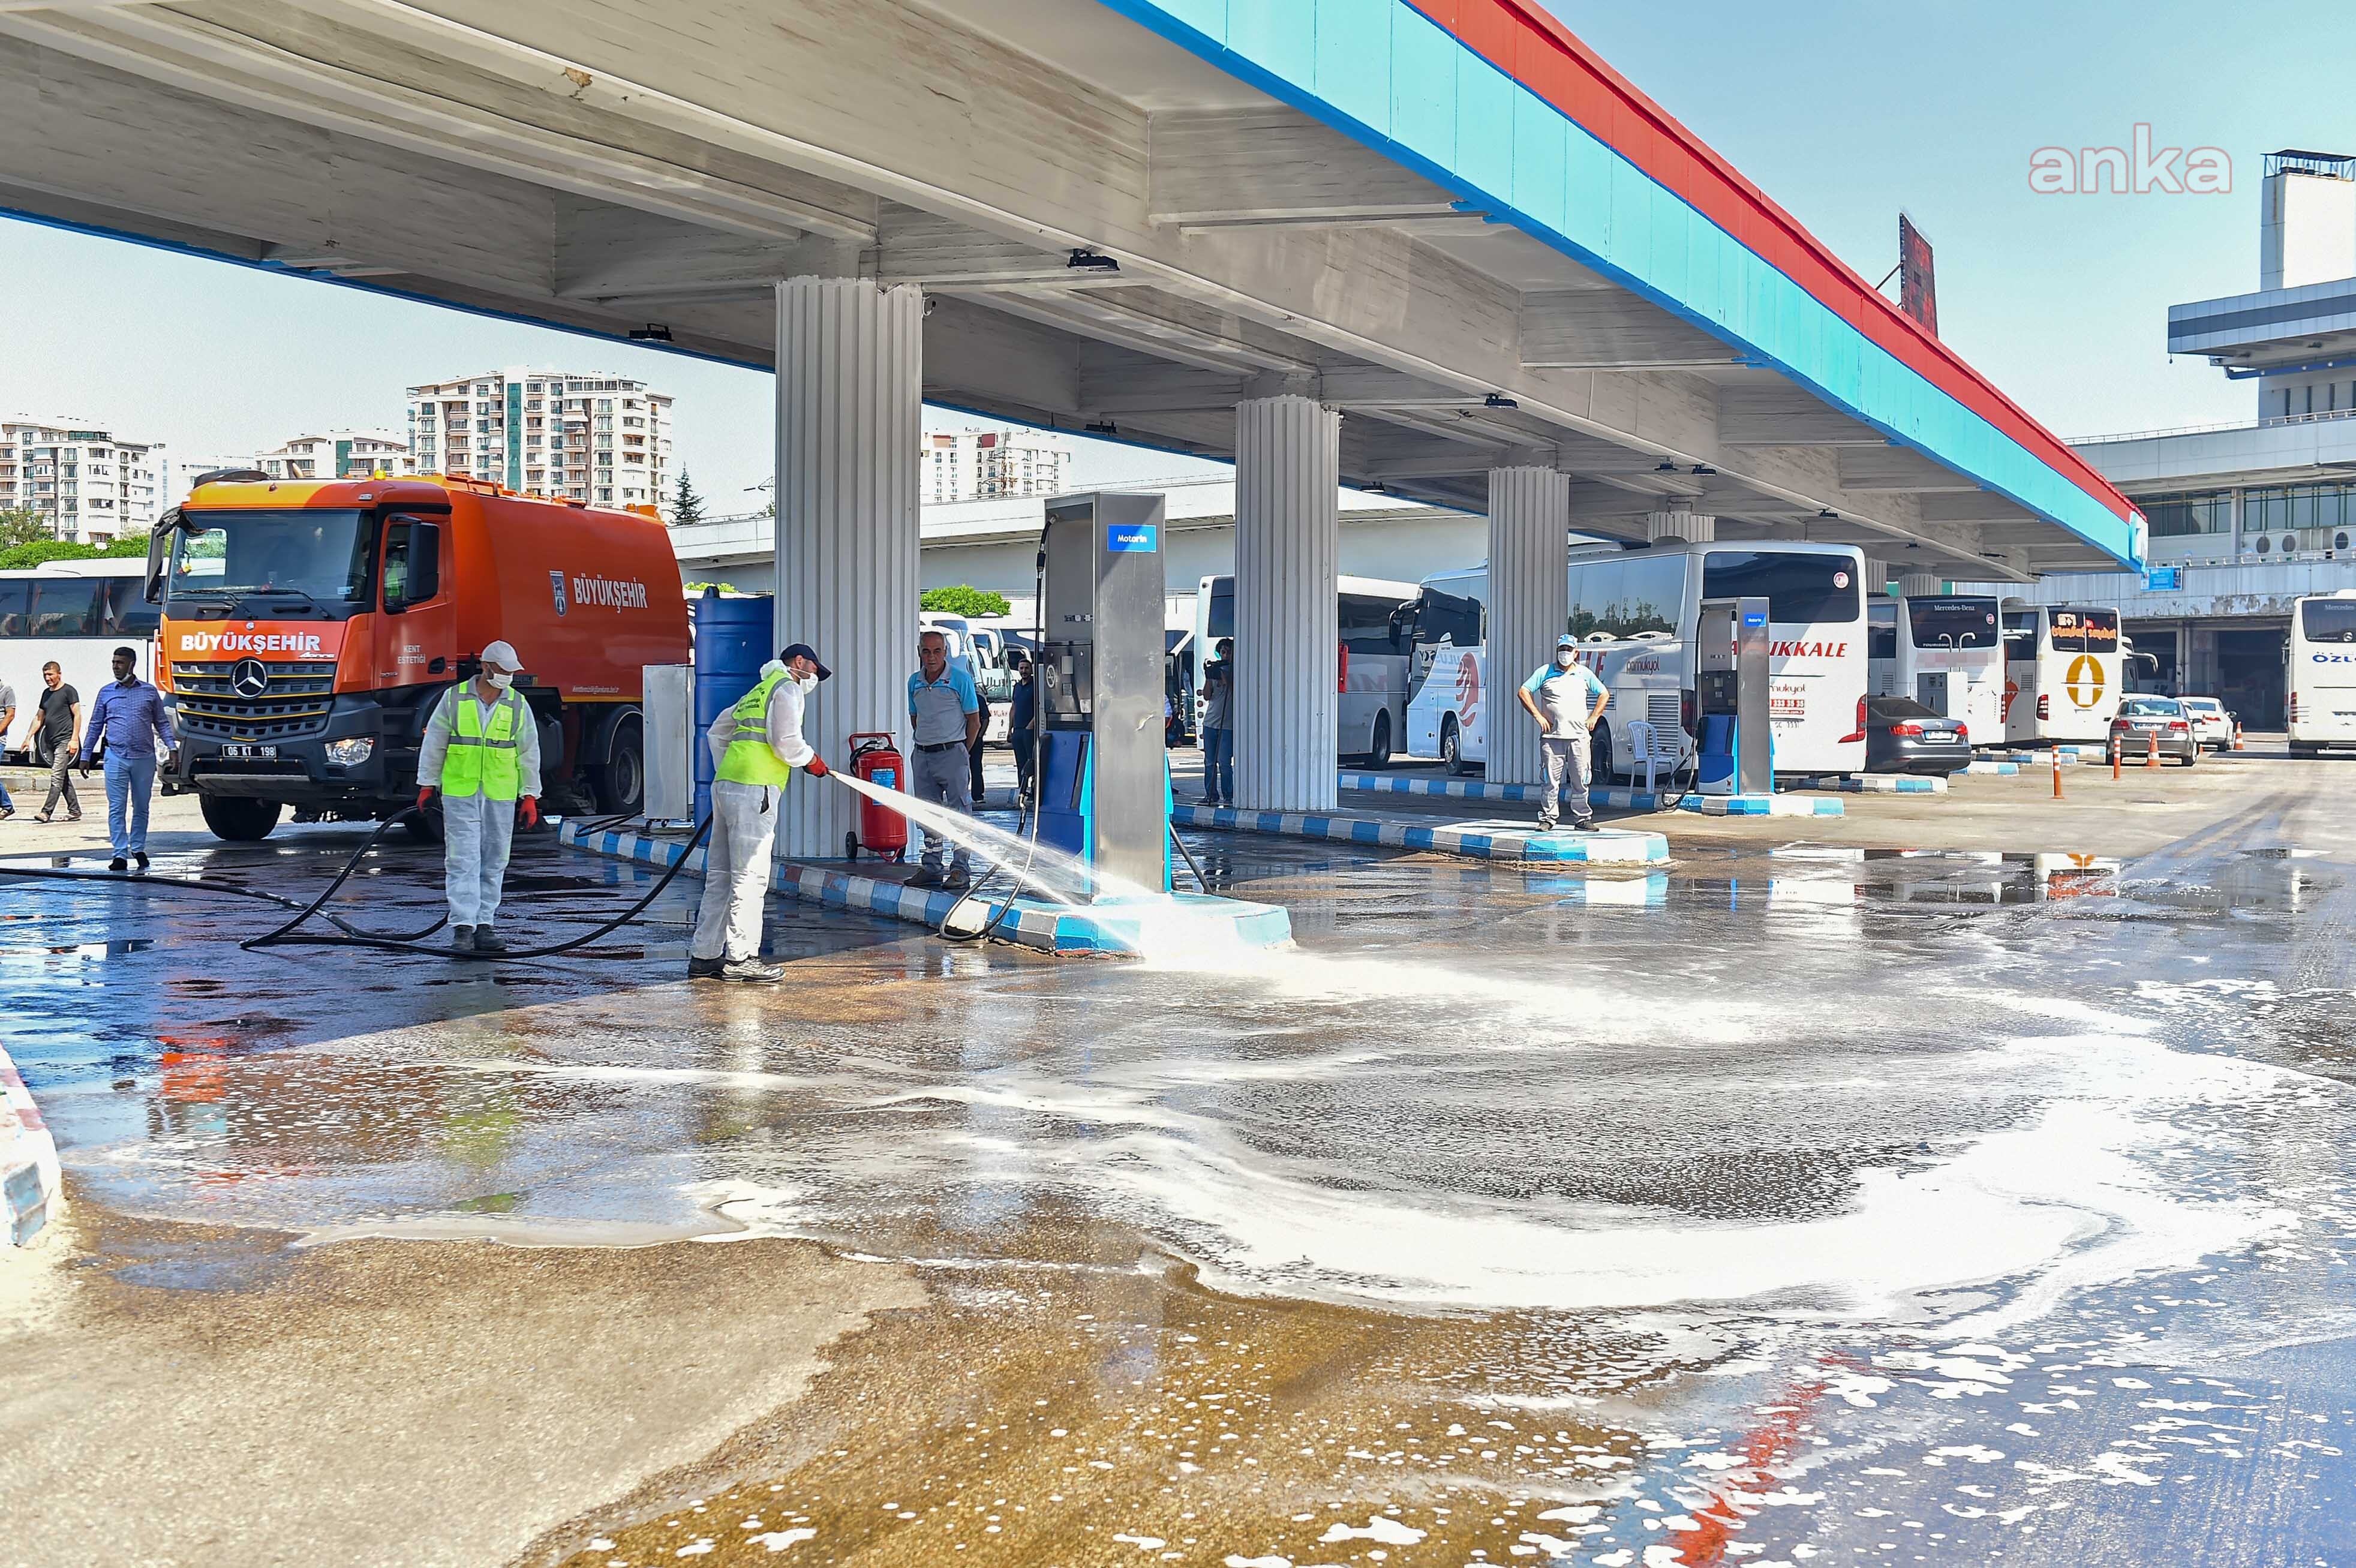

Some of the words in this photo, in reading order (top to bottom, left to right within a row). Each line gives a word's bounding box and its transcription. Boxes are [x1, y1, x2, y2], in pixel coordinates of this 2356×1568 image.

[1117, 534, 1147, 543] Motorin
[573, 572, 648, 614] BÜYÜKŞEHİR
[181, 632, 321, 655] BÜYÜKŞEHİR
[1626, 656, 1660, 675] pamukyol
[228, 746, 238, 756] 06
[242, 746, 252, 756] KT
[260, 747, 275, 756] 198
